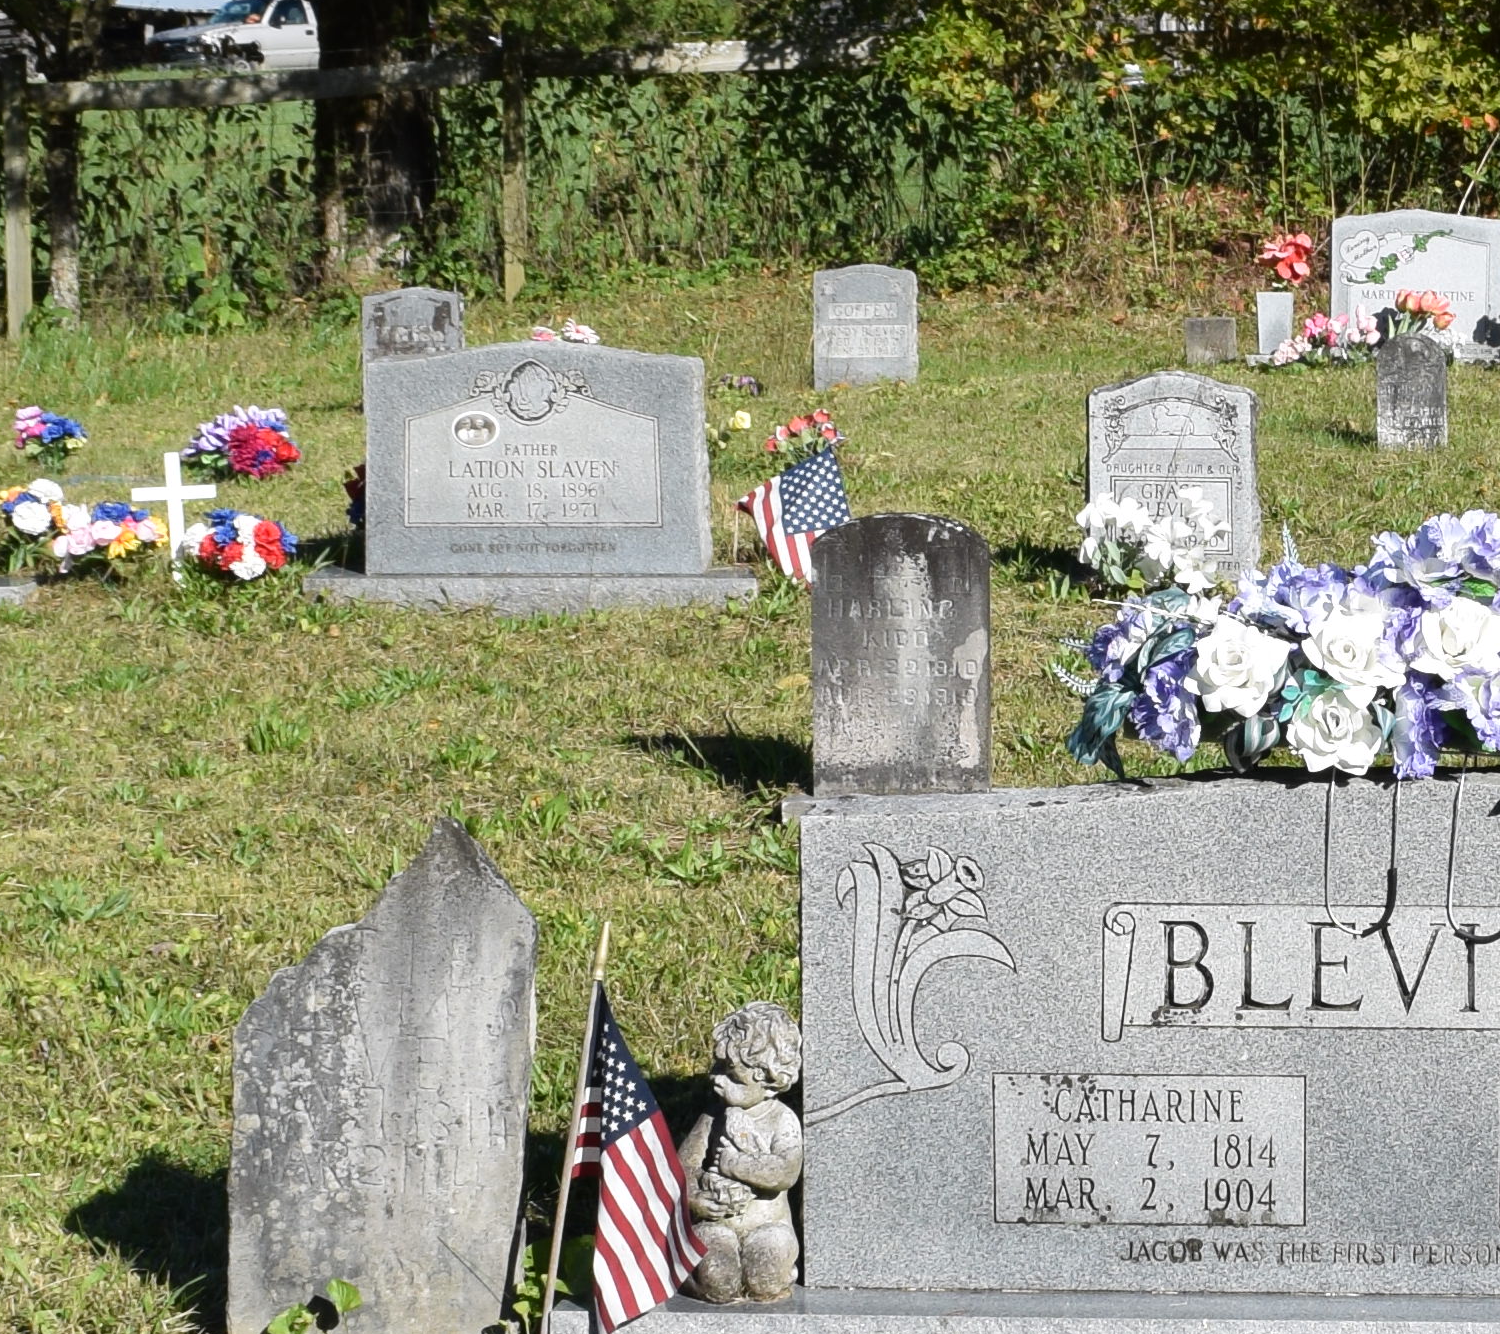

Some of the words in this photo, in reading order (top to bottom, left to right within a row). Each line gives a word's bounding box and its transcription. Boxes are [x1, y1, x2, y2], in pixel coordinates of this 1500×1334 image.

[1361, 290, 1396, 301] MART
[504, 444, 558, 456] FATHER
[449, 461, 524, 479] LATION
[537, 460, 618, 479] SLAVEN
[562, 483, 598, 498] 1896
[562, 503, 598, 517] 1971
[863, 629, 930, 650] KIDD
[1052, 1088, 1245, 1124] CATHARINE
[1026, 1133, 1095, 1166] MAY
[1144, 1134, 1175, 1171] 7,
[1212, 1134, 1277, 1169] 1814
[1024, 1177, 1112, 1212] MAR.
[1139, 1177, 1175, 1213] 2,
[1202, 1178, 1277, 1213] 1904
[1120, 1239, 1203, 1264] JACOB
[1212, 1241, 1264, 1263] WAS
[1276, 1241, 1324, 1265] THE
[1332, 1242, 1402, 1266] FIRST
